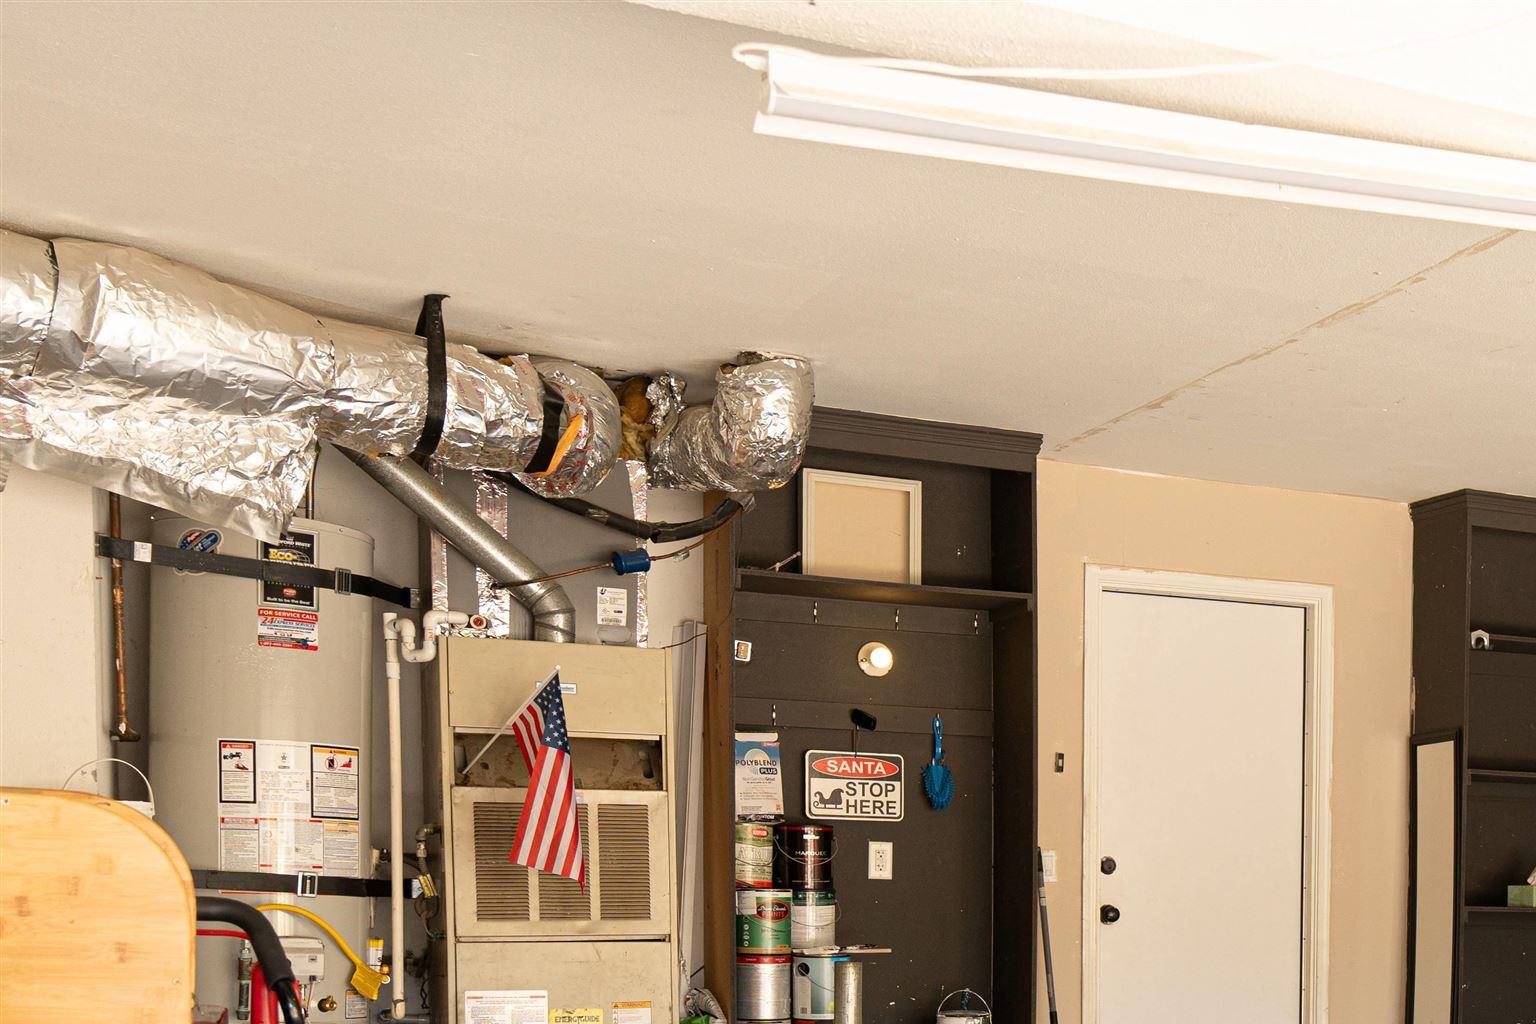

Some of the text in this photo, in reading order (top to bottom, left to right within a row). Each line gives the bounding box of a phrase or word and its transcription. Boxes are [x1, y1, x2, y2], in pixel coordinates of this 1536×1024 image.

[274, 610, 301, 619] SERVICE
[826, 760, 887, 775] SANTA
[845, 781, 896, 797] STOP
[845, 799, 897, 815] HERE
